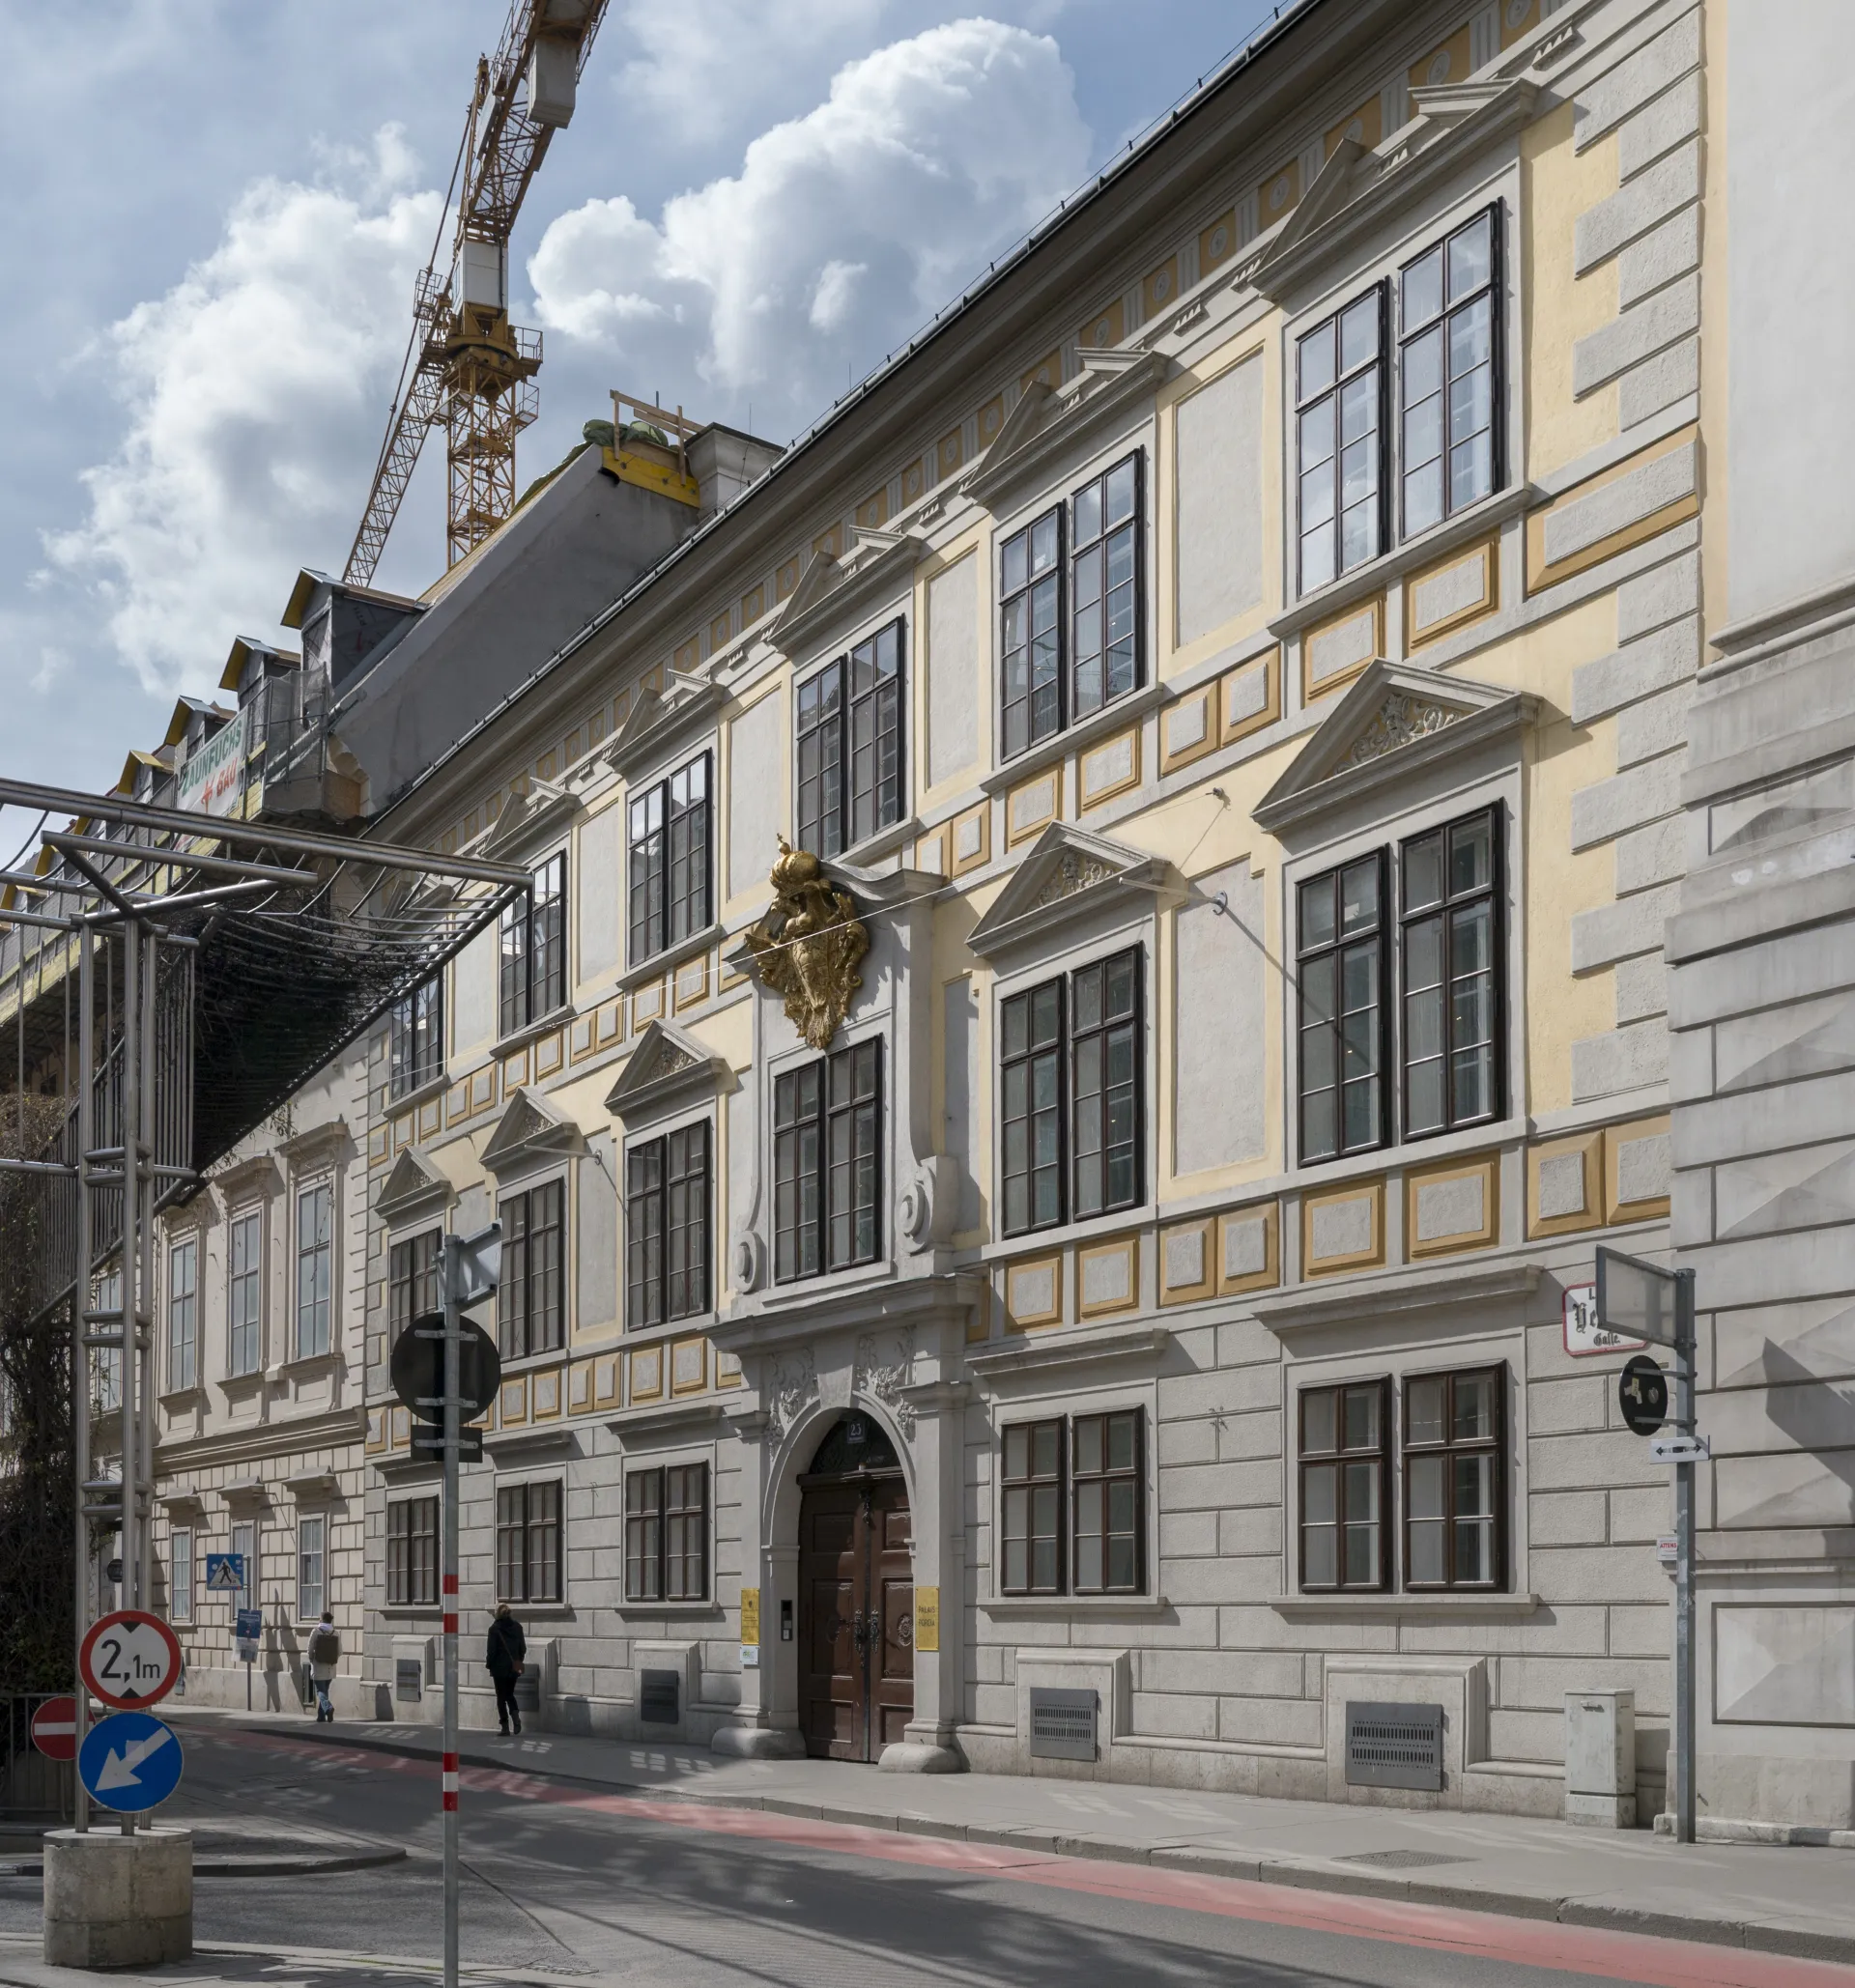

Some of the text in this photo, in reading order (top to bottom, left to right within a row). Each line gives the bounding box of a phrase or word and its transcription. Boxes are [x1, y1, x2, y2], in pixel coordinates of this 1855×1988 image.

[182, 719, 243, 797] ZAUNFUCHS
[850, 1423, 862, 1436] 23
[918, 1605, 935, 1614] PALAIS
